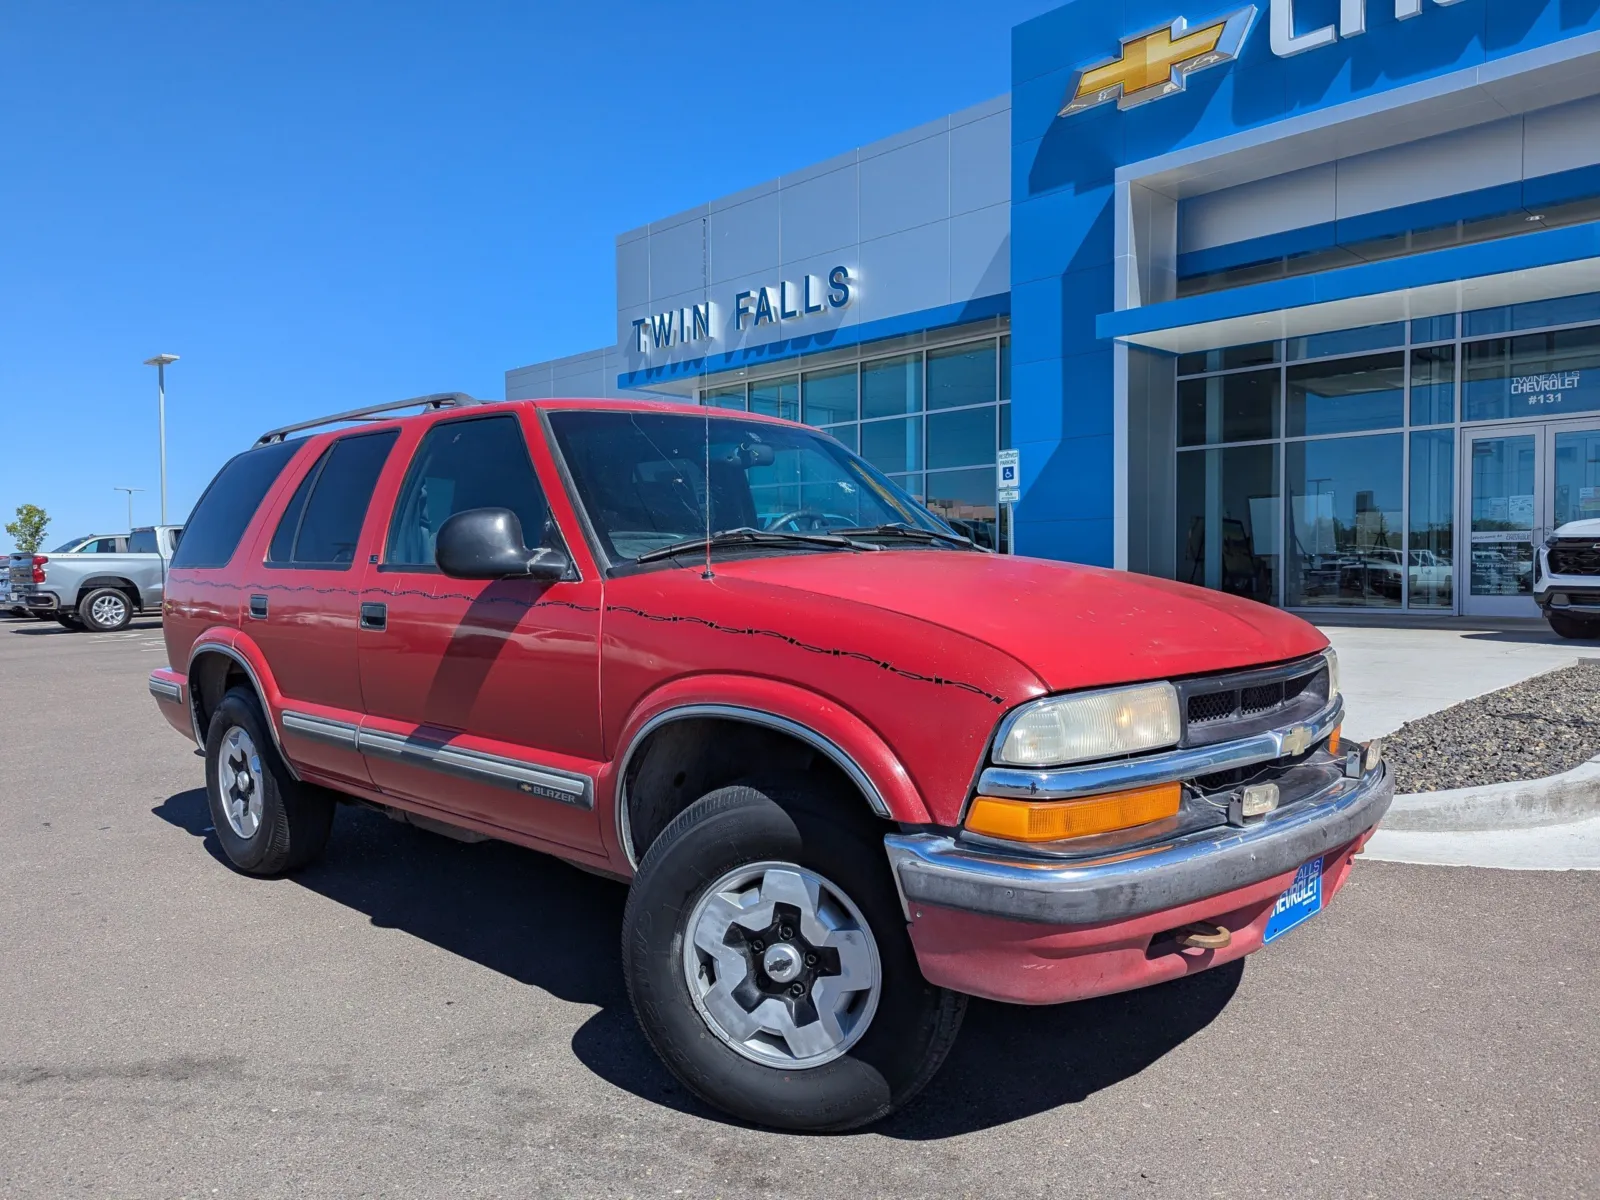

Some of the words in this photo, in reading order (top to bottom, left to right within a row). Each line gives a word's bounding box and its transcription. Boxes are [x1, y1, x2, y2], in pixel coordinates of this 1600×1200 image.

[632, 301, 714, 352] TWIN
[734, 265, 856, 331] FALLS
[1511, 377, 1580, 395] CHEVROLET
[1528, 392, 1562, 405] #131
[533, 786, 576, 803] BLAZER
[1295, 860, 1319, 880] ALLS
[1271, 872, 1318, 917] HEVROLET
